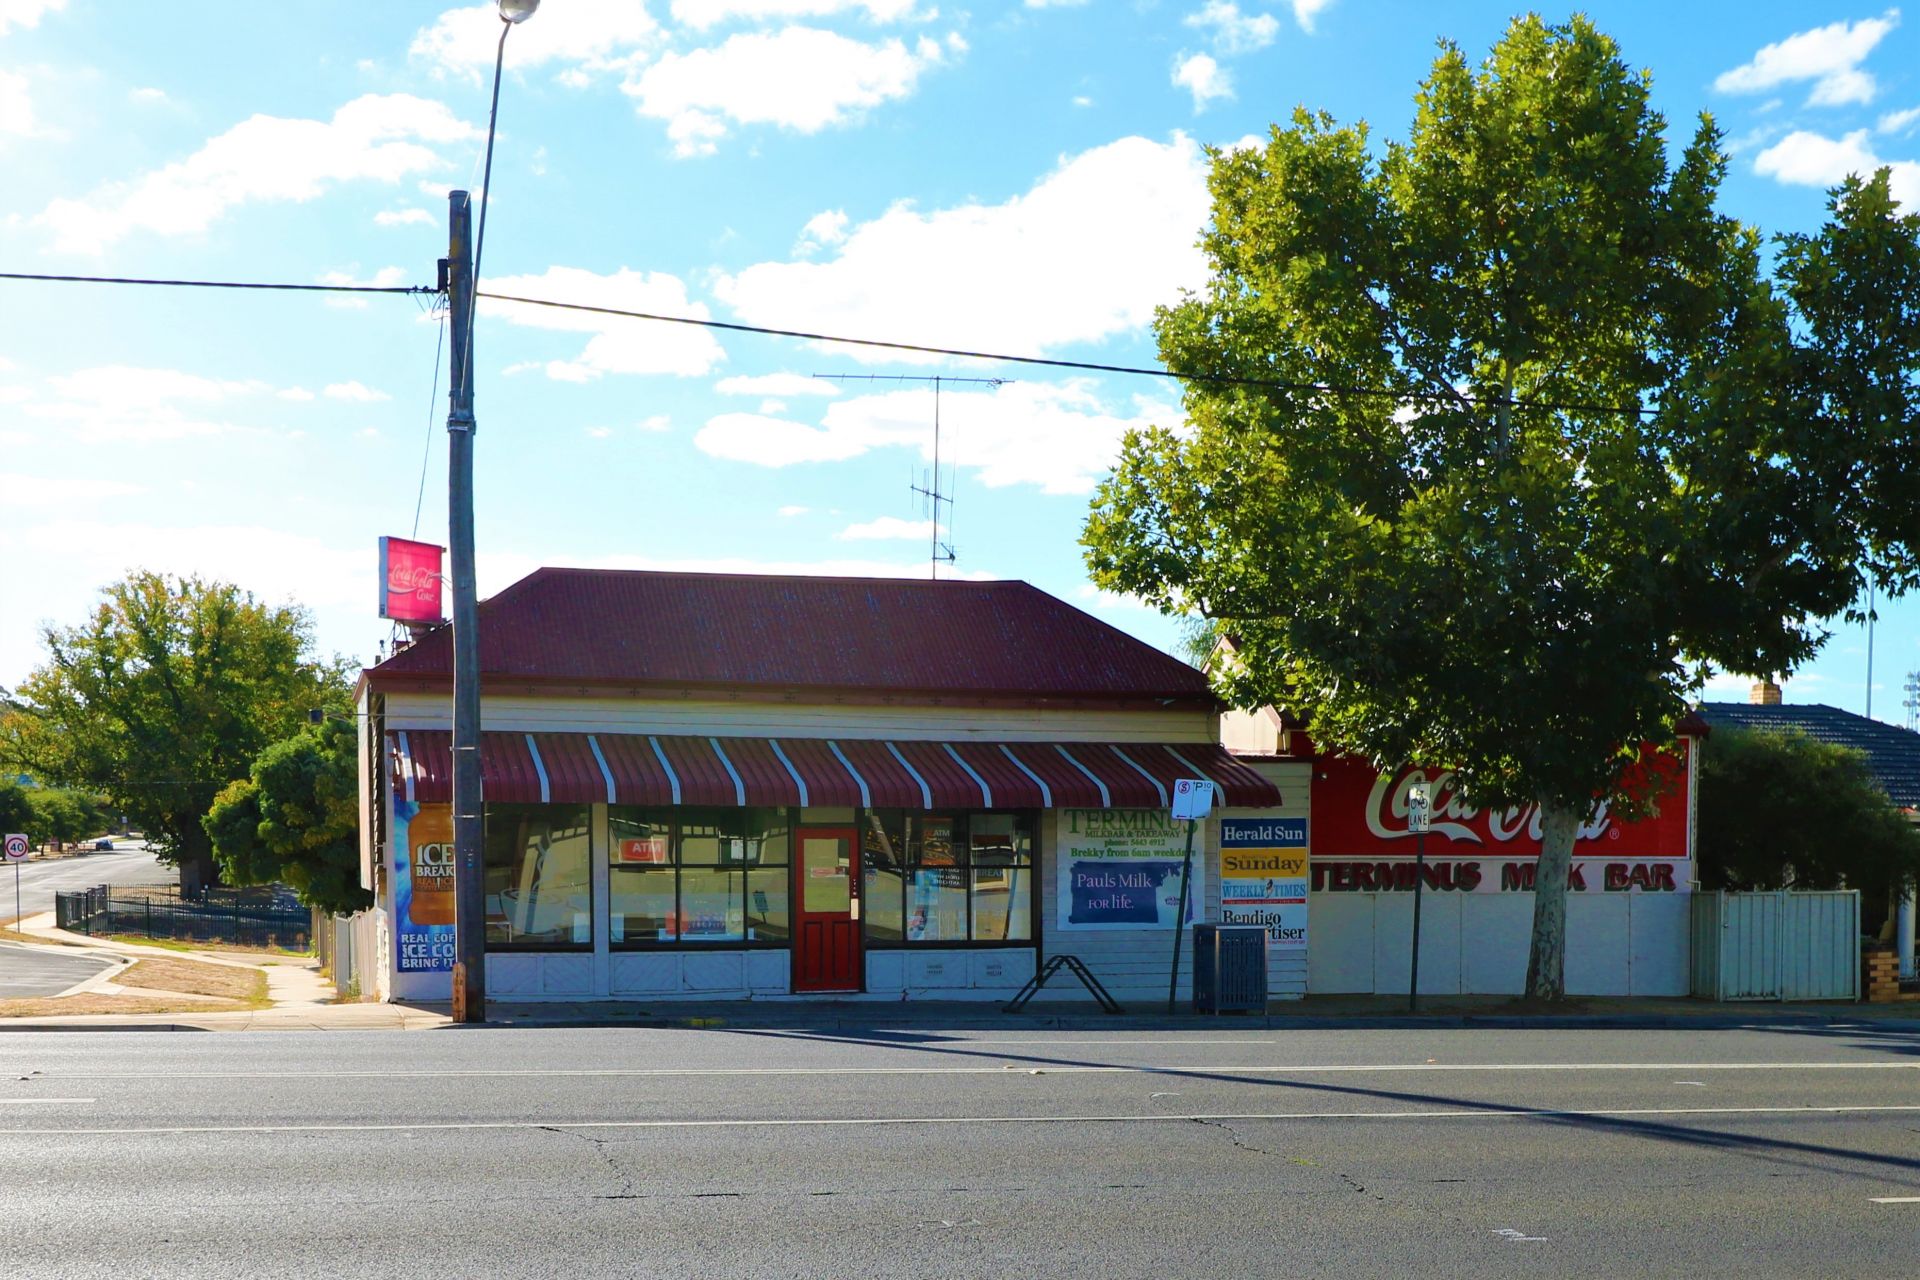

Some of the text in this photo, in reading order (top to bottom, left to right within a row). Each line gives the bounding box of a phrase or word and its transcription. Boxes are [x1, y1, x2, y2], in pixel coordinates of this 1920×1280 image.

[417, 589, 434, 601] Coke
[1410, 814, 1427, 826] LANE
[934, 829, 950, 837] ATM
[1085, 830, 1124, 838] MILKBAR
[1135, 830, 1180, 838] TAKEAWAY
[1224, 826, 1304, 840] Herald Sun
[10, 843, 24, 852] 40
[632, 843, 661, 853] ATM
[1071, 847, 1104, 858] Brekky
[1107, 847, 1128, 857] from
[415, 843, 454, 866] ICE
[1224, 855, 1304, 874] Sunday
[416, 866, 454, 877] BREAK
[1310, 862, 1482, 892] TERMINUS
[1604, 863, 1677, 892] BAR
[1077, 873, 1152, 888] Pauls Milk
[1222, 884, 1306, 898] WEEKLY TIMES
[1088, 899, 1109, 909] FOR
[1223, 910, 1281, 928] Bendigo
[401, 934, 430, 943] REAL
[402, 944, 428, 958] ICE
[402, 958, 439, 968] BRING
